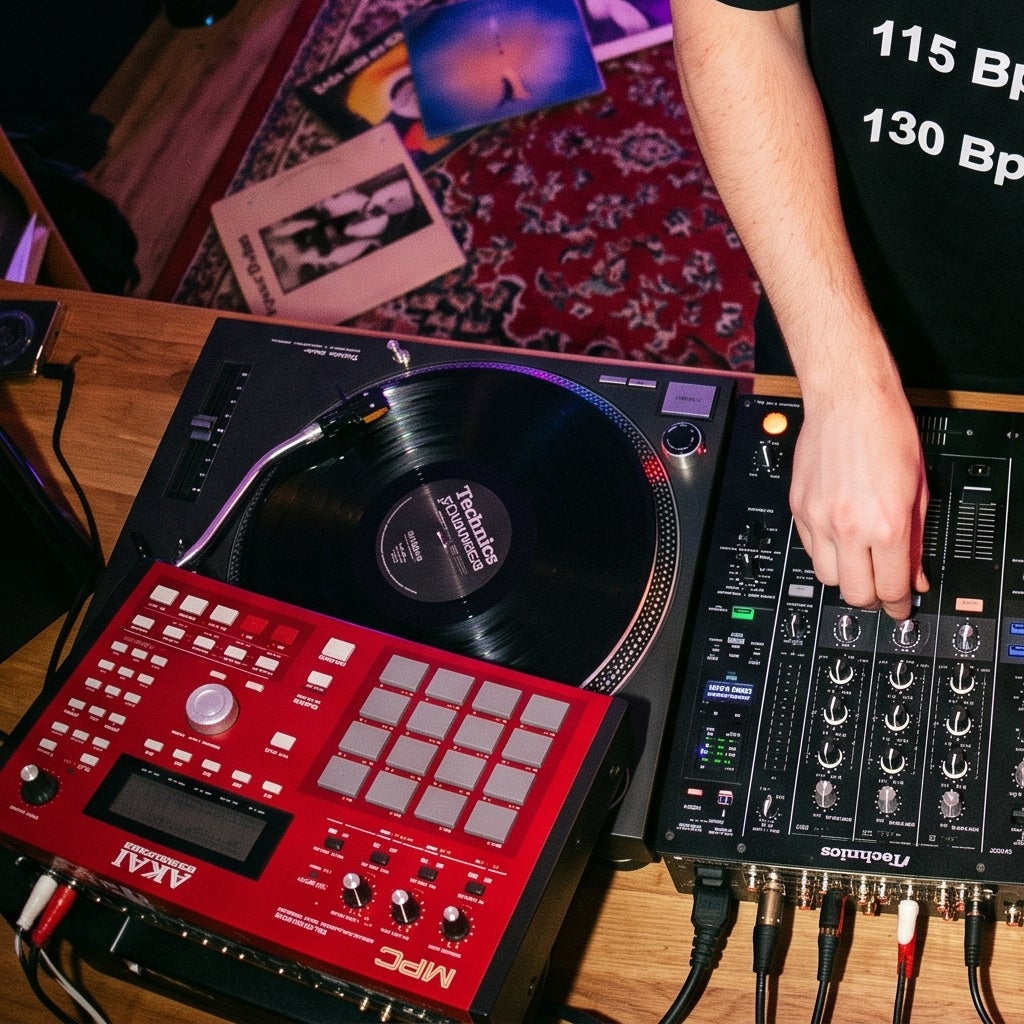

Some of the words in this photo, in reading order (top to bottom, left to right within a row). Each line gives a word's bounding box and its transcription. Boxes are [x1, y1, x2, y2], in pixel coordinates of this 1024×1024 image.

[872, 19, 957, 74] 115
[863, 108, 945, 156] 130
[455, 484, 499, 566] Technics
[111, 848, 190, 890] AKAI
[374, 945, 457, 990] MPC
